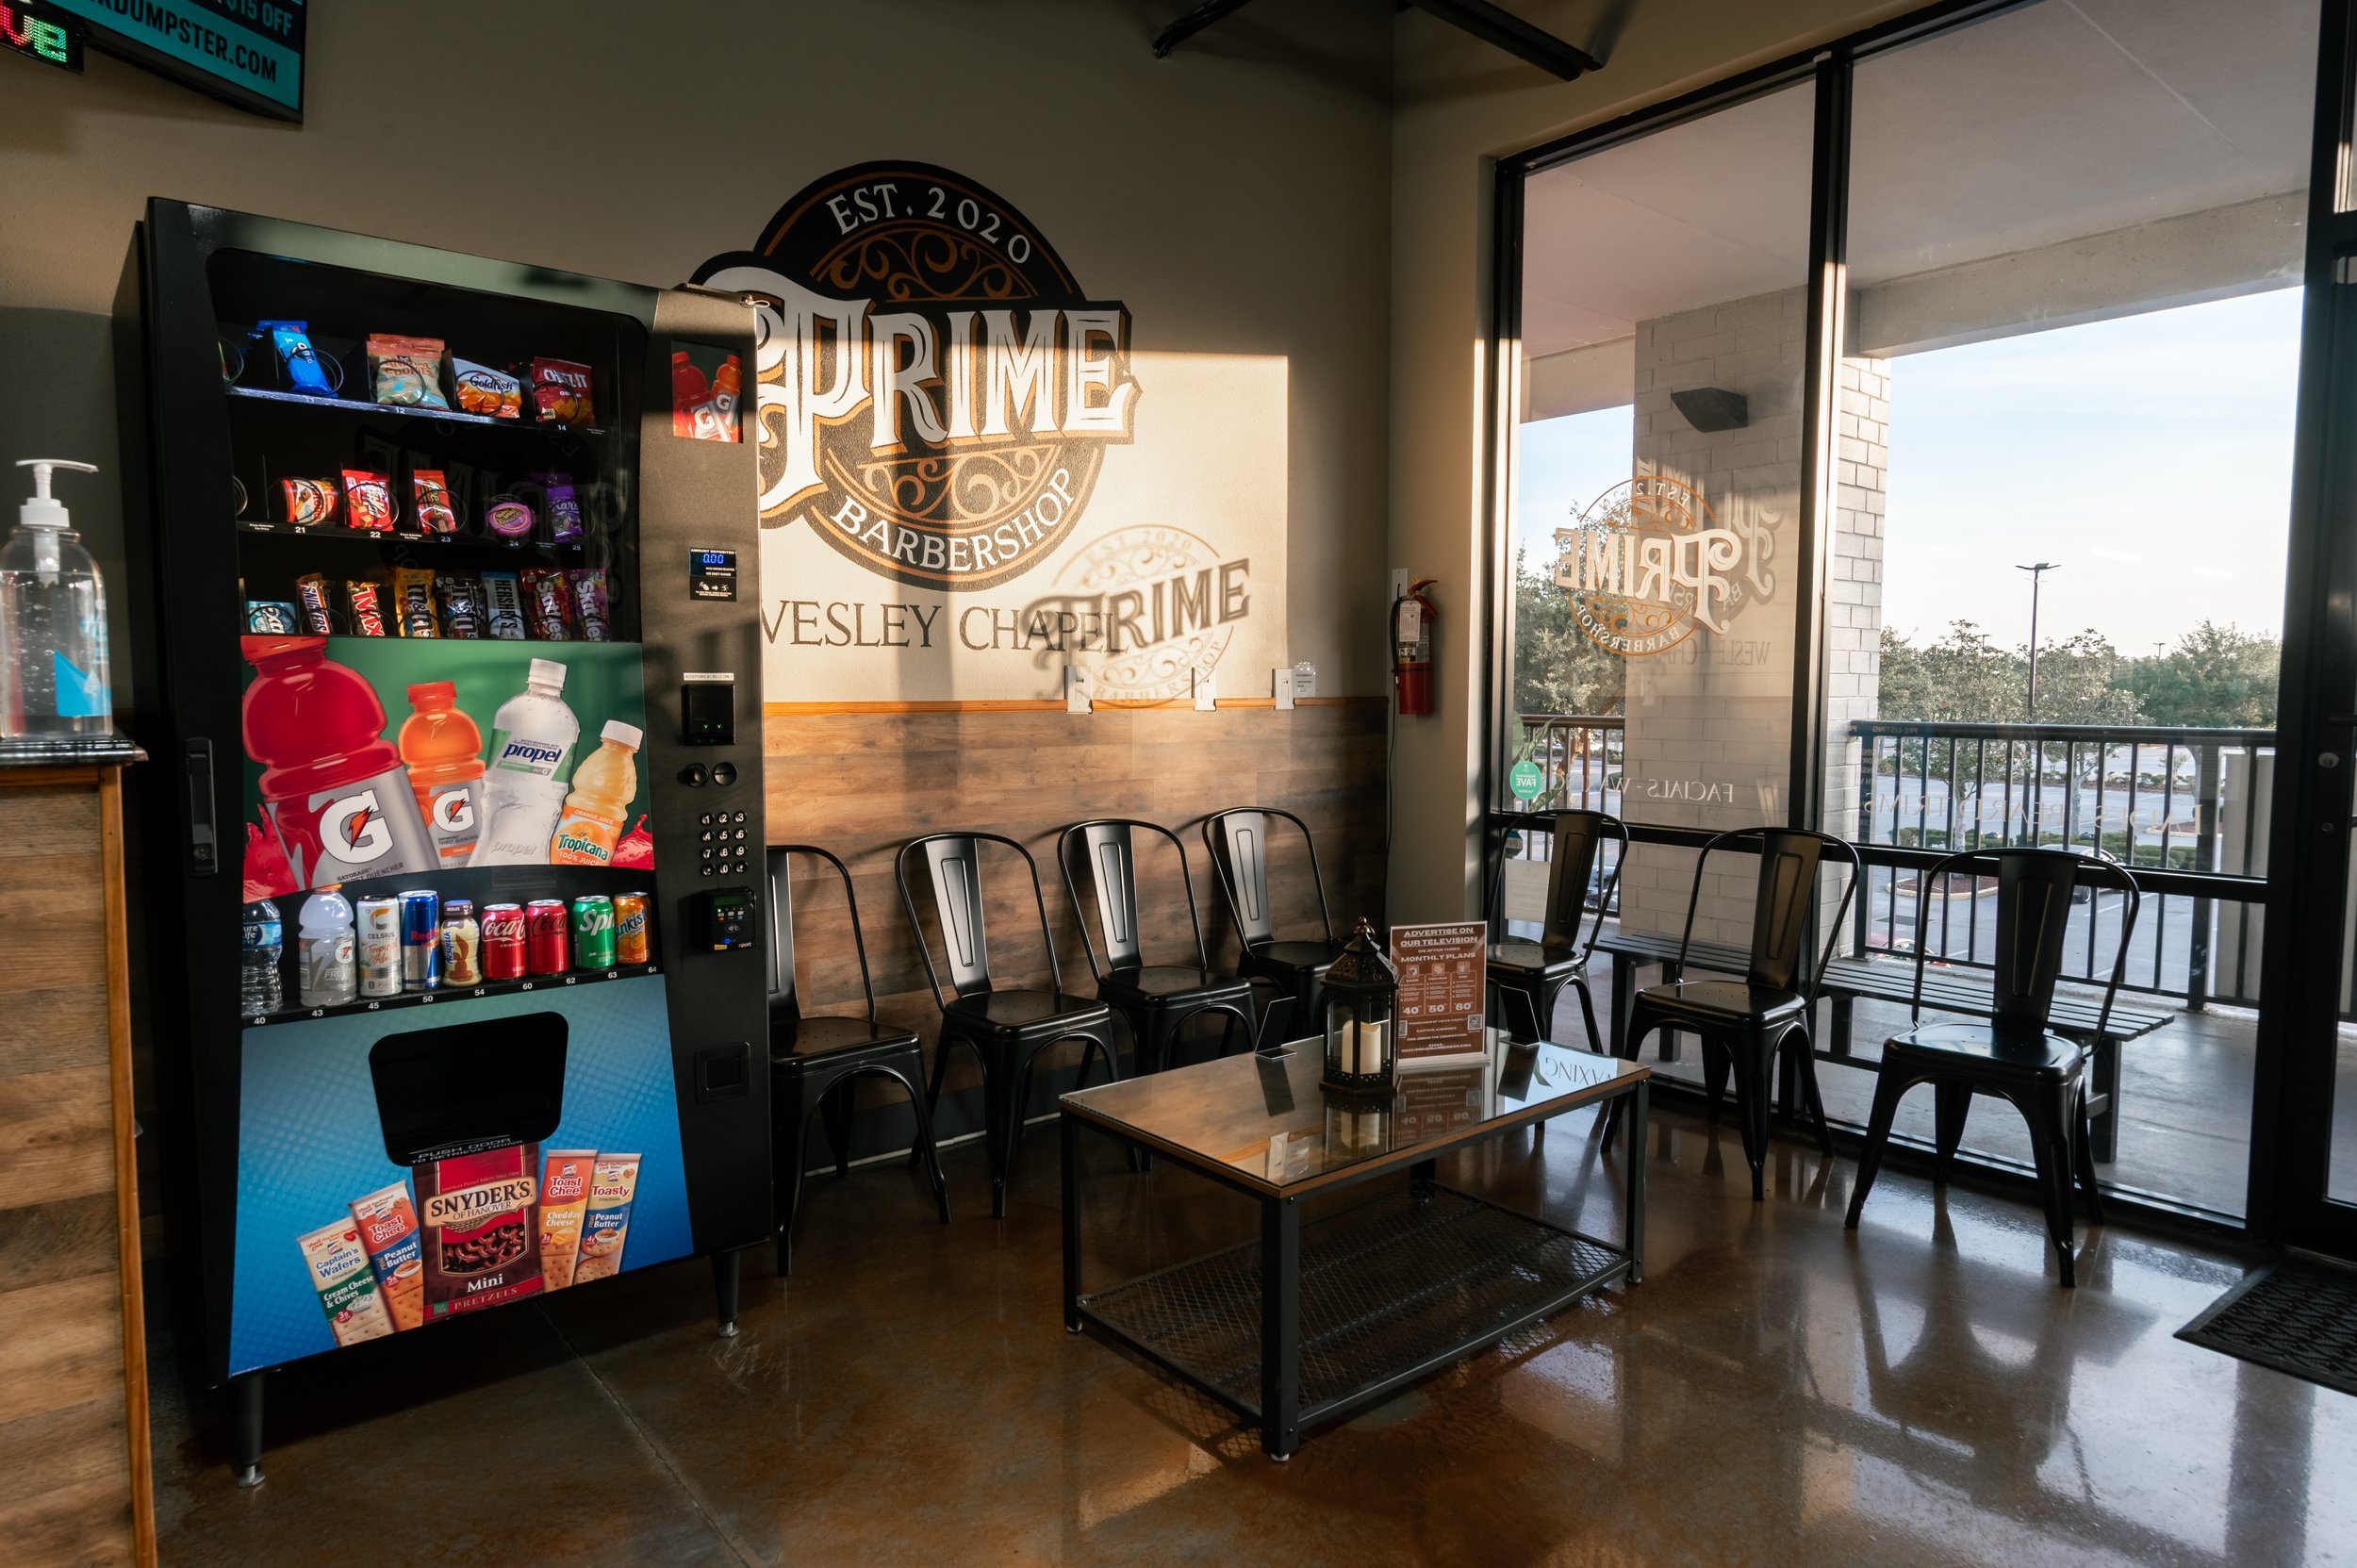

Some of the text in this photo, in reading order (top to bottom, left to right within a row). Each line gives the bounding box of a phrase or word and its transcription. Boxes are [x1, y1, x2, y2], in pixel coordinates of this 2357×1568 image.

[262, 2, 293, 37] OFF
[927, 187, 1030, 264] 2020
[470, 375, 513, 393] Goldfish
[703, 267, 1135, 510] PRIME
[694, 406, 716, 430] G
[831, 467, 1075, 572] BARBERSHOP
[959, 606, 1129, 654] CHAPEL
[503, 743, 563, 763] propel
[432, 787, 475, 833] G
[574, 809, 614, 825] ORANGE JUICE
[738, 814, 744, 822] 3
[319, 787, 394, 865] G
[705, 833, 711, 841] 4
[738, 830, 744, 838] 6
[557, 833, 609, 862] Tropicana
[559, 851, 578, 861] 100%
[705, 847, 744, 858] 7 8 9
[722, 865, 728, 873] 0
[410, 928, 433, 942] Red
[1404, 928, 1458, 938] ADVERTISE
[1422, 936, 1478, 946] TELEVISION
[443, 931, 453, 965] Nesquik
[1400, 954, 1444, 963] MONTHLY
[1403, 1006, 1419, 1015] 40
[1428, 1004, 1445, 1013] 50
[1456, 1002, 1472, 1011] 60
[418, 1137, 512, 1159] PUSH DOOR
[430, 1147, 485, 1161] RETRIEVE
[487, 1139, 524, 1149] DRINK
[552, 1176, 583, 1186] Toast
[431, 1180, 531, 1218] SNYDER'S
[549, 1185, 581, 1197] Chee
[592, 1185, 630, 1197] Toasty
[453, 1201, 512, 1220] OF HANOVER
[547, 1211, 581, 1219] Cheddar
[595, 1213, 623, 1221] Peanut
[369, 1214, 404, 1234] Toast
[546, 1218, 574, 1227] Cheese
[594, 1220, 619, 1229] Butter
[372, 1224, 405, 1243] Chee
[316, 1246, 359, 1270] Captain's
[384, 1241, 418, 1262] Peanut
[386, 1250, 417, 1268] Butter
[319, 1255, 361, 1279] Wafers
[323, 1275, 374, 1301] Cream Cheese
[467, 1273, 504, 1293] Mini
[326, 1289, 359, 1309] & Chives
[454, 1286, 518, 1311] PRETZELS
